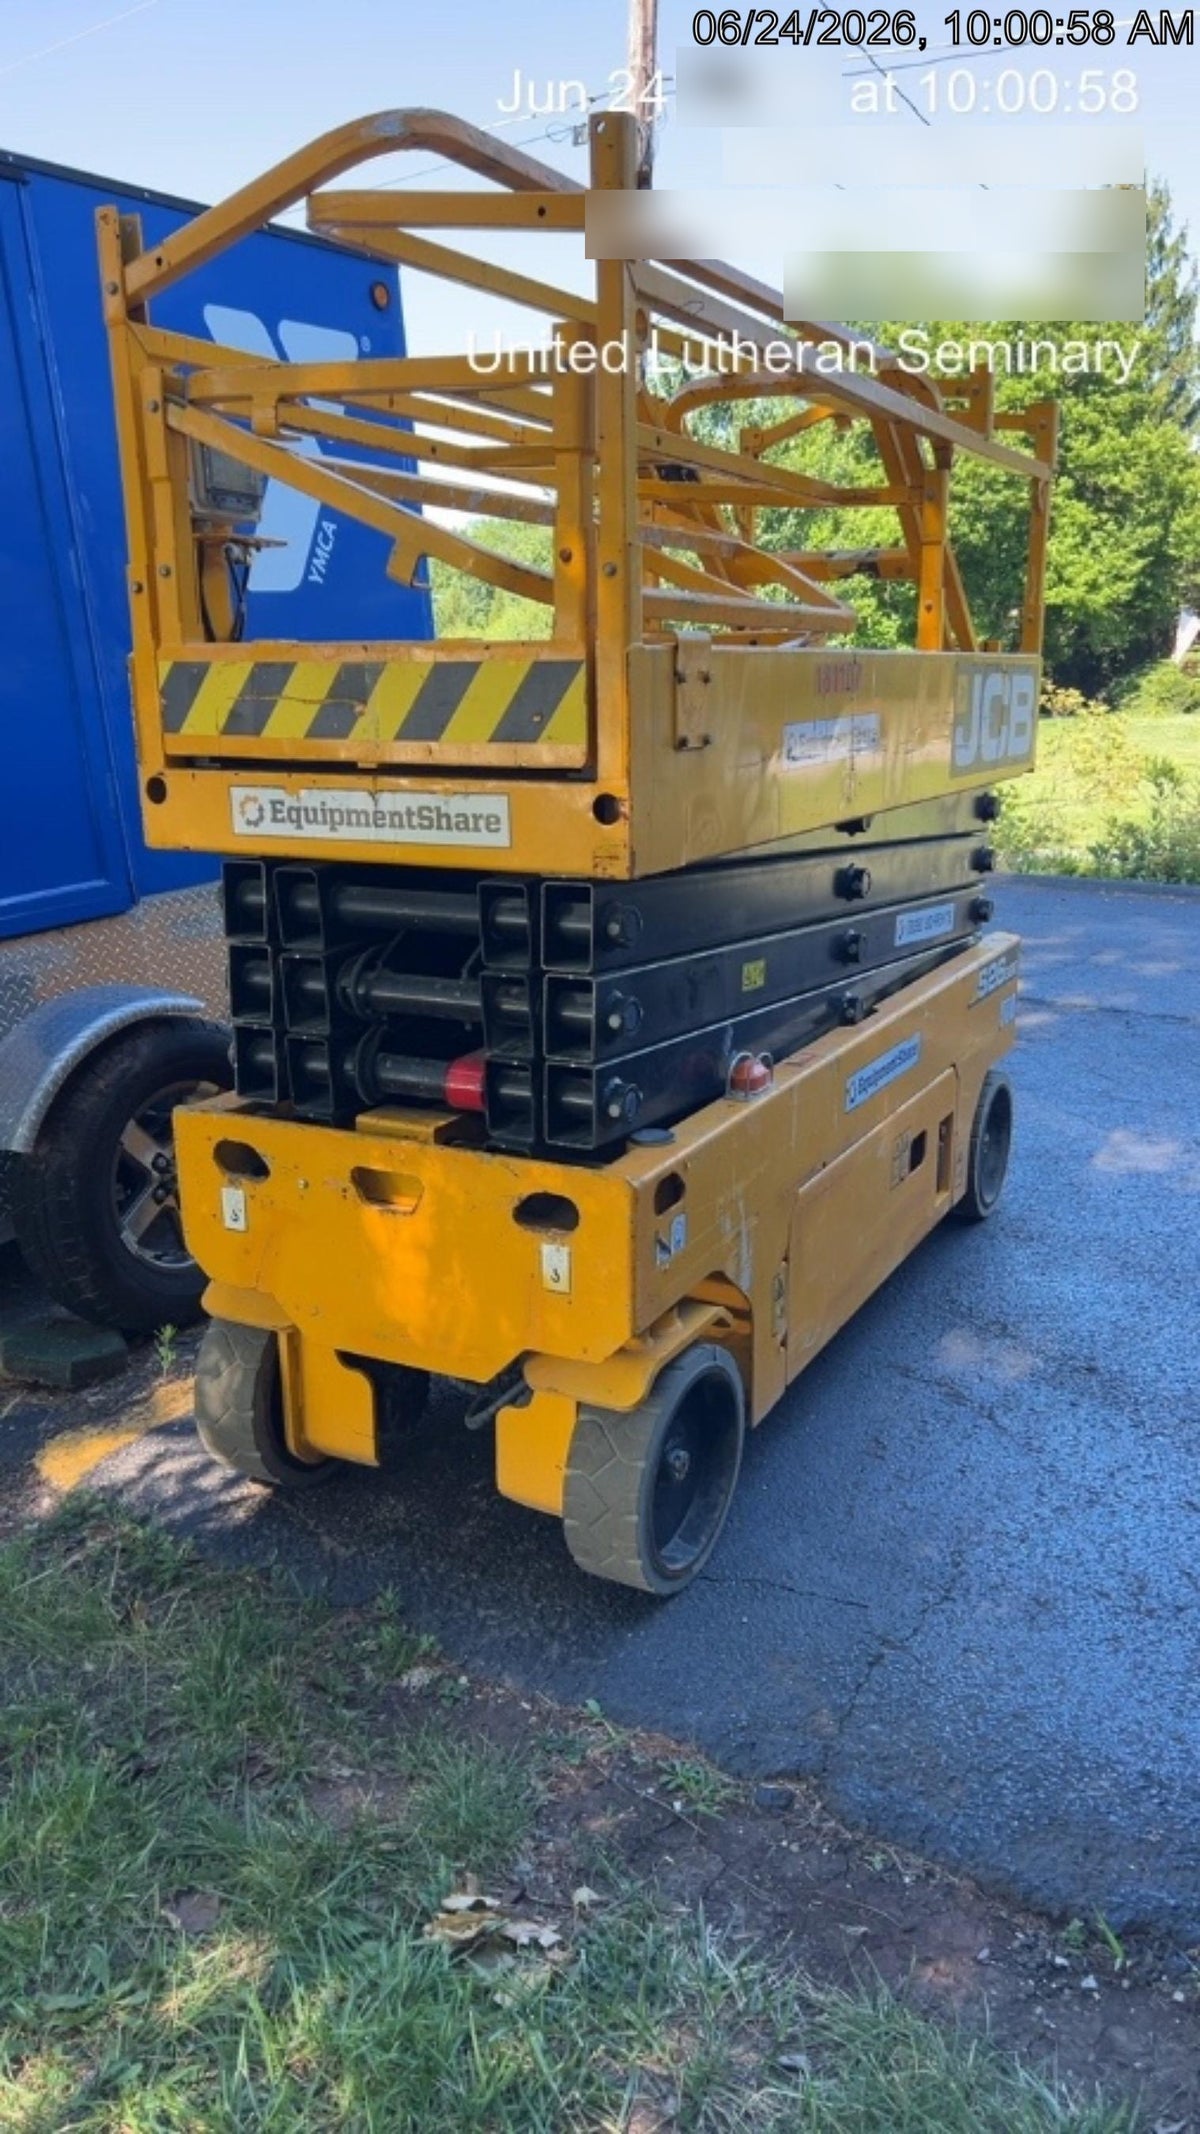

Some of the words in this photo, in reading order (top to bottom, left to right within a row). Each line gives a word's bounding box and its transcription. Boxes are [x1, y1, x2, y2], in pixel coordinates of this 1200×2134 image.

[307, 520, 338, 584] YMCA
[954, 671, 1035, 767] JCB
[268, 799, 502, 834] EquipmentShare
